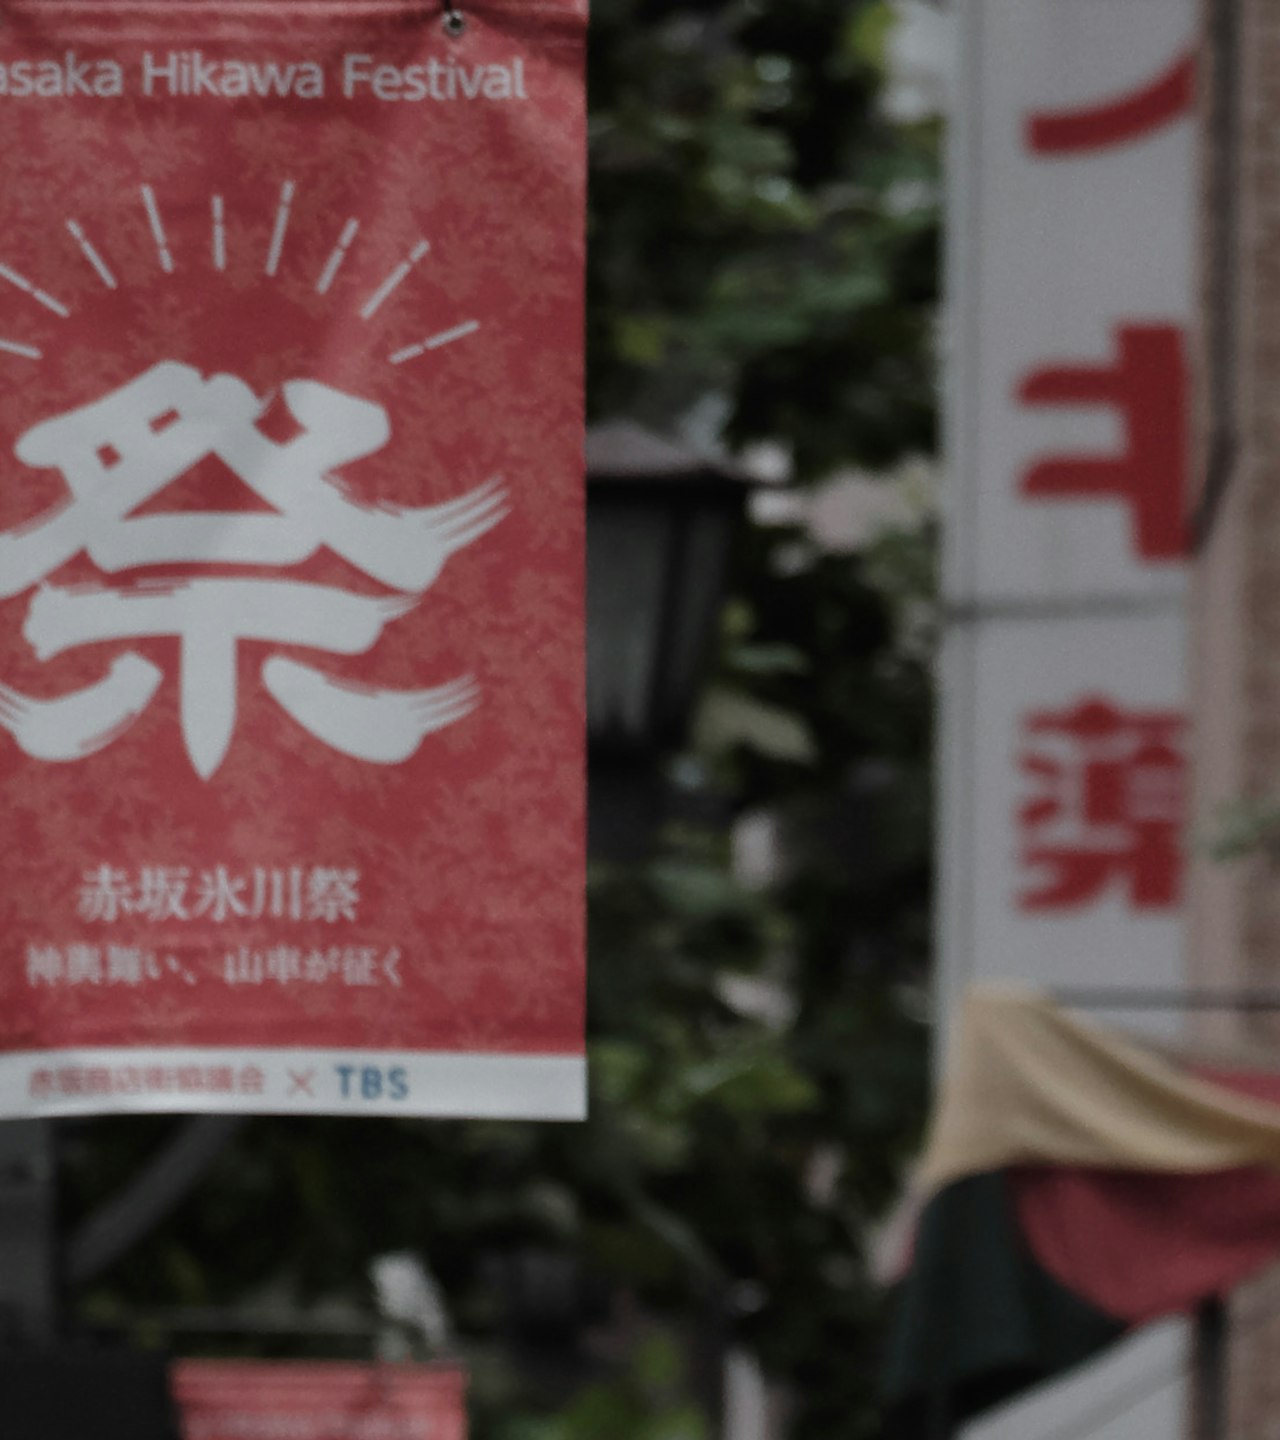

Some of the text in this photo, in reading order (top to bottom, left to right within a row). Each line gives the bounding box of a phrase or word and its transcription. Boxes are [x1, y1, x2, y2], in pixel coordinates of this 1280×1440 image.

[142, 53, 324, 99] Hikawa
[343, 54, 528, 102] Festival
[77, 863, 360, 923] 赤坂氷川祭
[334, 1064, 411, 1100] TBS
